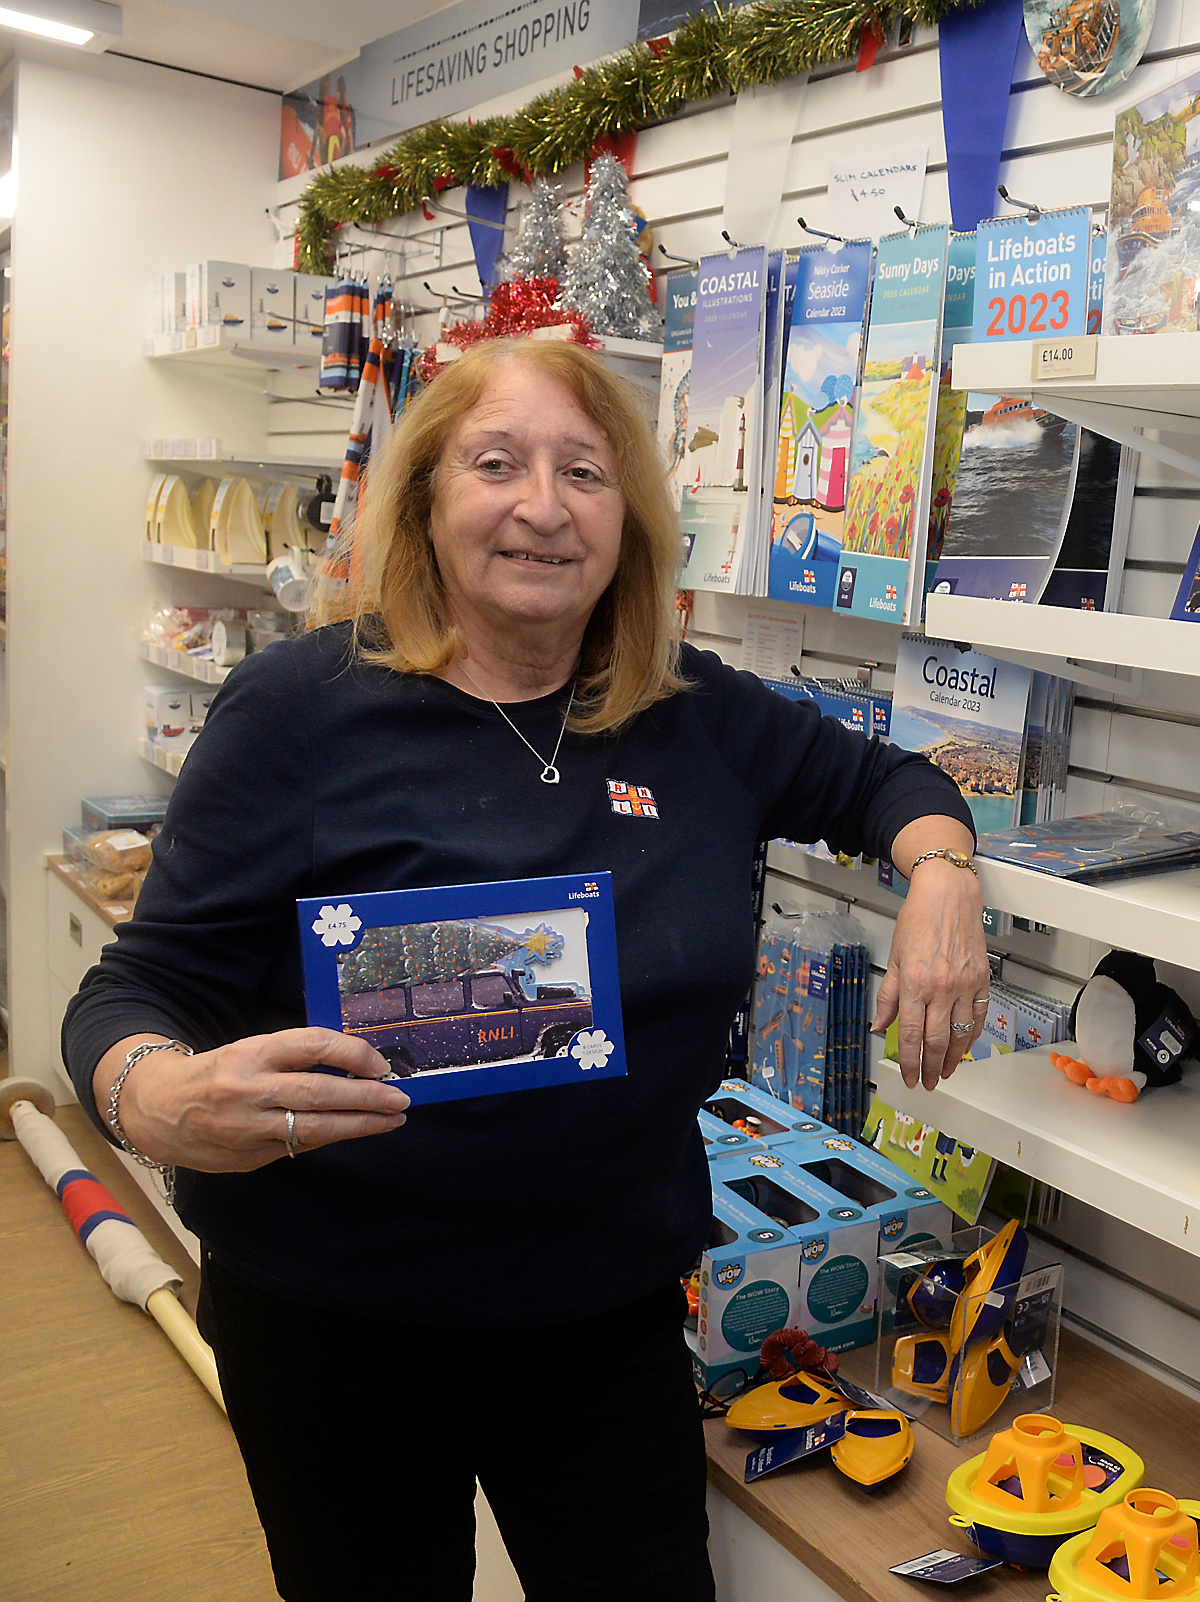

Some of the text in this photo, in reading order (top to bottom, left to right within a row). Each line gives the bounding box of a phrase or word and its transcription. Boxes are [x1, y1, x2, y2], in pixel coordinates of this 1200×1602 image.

[391, 0, 590, 106] LIFESAVING SHOPPING
[833, 173, 857, 183] SLIM
[988, 232, 1076, 263] Lifeboats
[813, 265, 829, 278] Nikky
[878, 257, 939, 282] Sunny Days
[947, 264, 976, 286] Days
[988, 267, 1006, 289] in
[1011, 260, 1071, 287] Action
[700, 269, 759, 296] COASTAL
[807, 279, 850, 300] Seaside
[899, 284, 930, 297] CALENDAR
[672, 290, 698, 309] You &
[702, 293, 753, 309] ILLUSTRATIONS
[805, 307, 831, 319] Calendar
[831, 305, 846, 317] 2023
[986, 289, 1070, 336] 2023
[1042, 347, 1073, 362] £14.00
[703, 572, 731, 584] Lifeboats
[789, 580, 817, 594] Lifeboats
[869, 597, 897, 612] Lifeboats
[922, 655, 998, 700] Coastal
[929, 689, 981, 713] Calendar 2023
[568, 890, 600, 900] Lifeboats
[327, 920, 348, 930] £4.75
[478, 1025, 515, 1045] RNLI
[1164, 1016, 1185, 1041] Lifeboats
[883, 1218, 905, 1234] WOW
[803, 1243, 826, 1259] WOW
[830, 1264, 845, 1272] WOW
[845, 1261, 861, 1269] Story
[717, 1268, 742, 1283] WOW
[747, 1289, 763, 1298] WOW
[763, 1286, 780, 1295] Story
